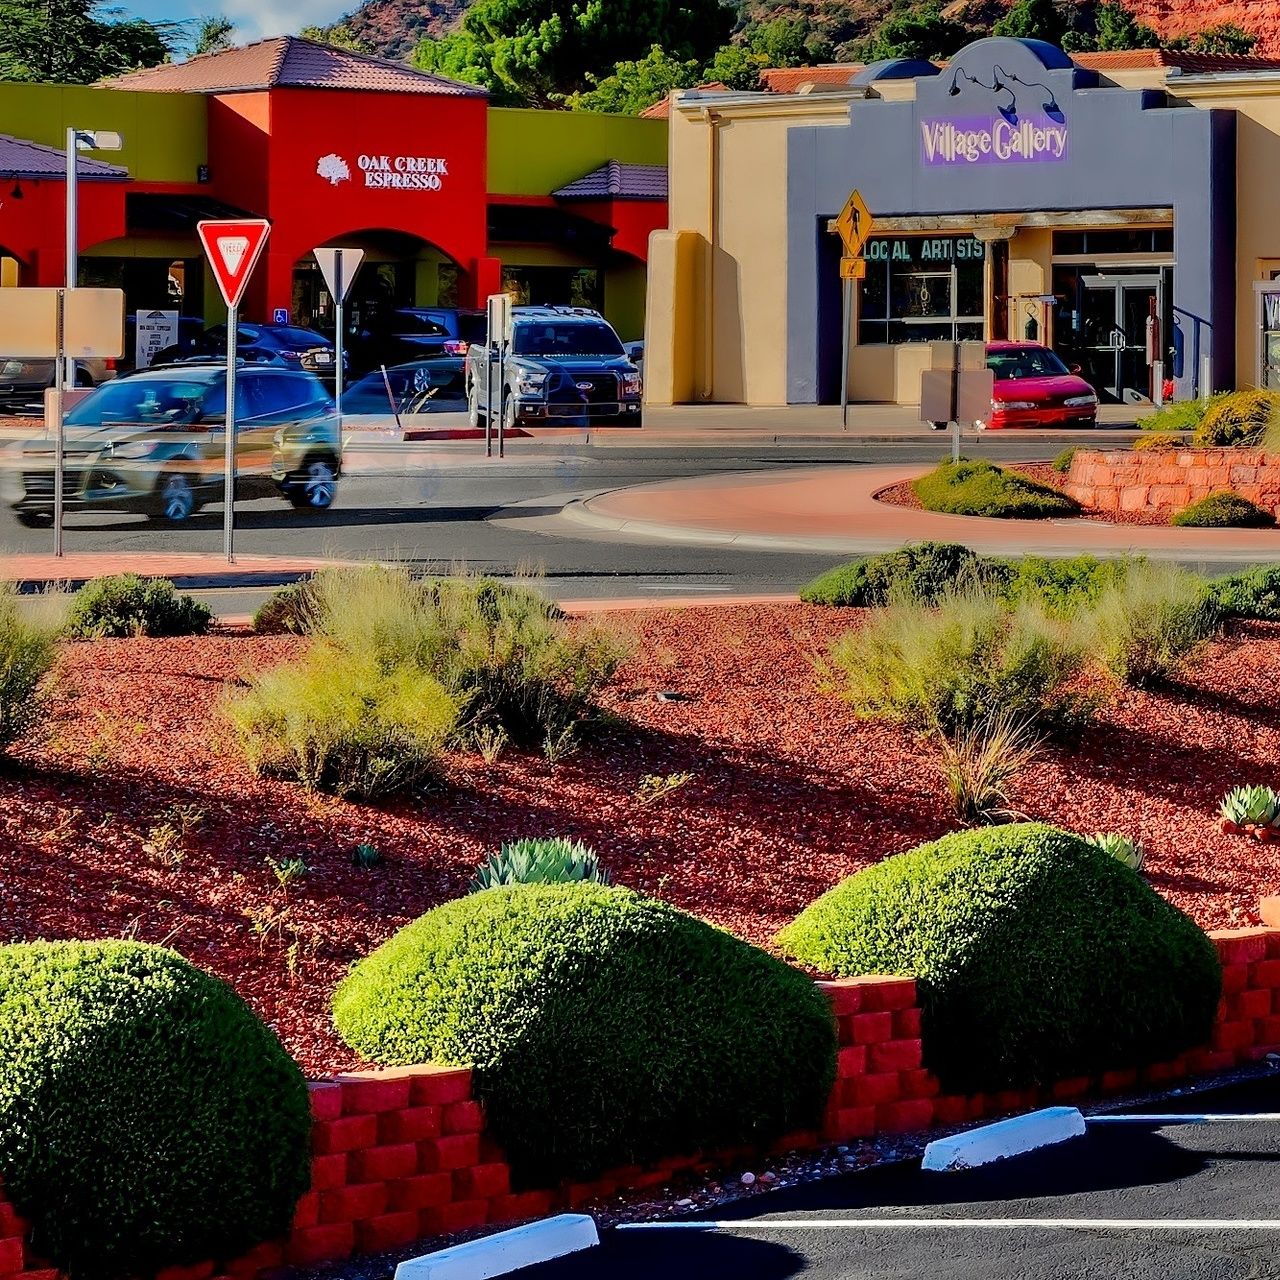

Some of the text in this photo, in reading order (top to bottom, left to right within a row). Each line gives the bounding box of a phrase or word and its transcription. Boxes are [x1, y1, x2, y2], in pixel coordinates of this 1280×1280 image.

[921, 119, 1067, 162] Village Gallery
[358, 155, 447, 174] OAK CREEK
[365, 171, 442, 191] ESPRESSO
[863, 238, 983, 260] LOCAL ARTISTS
